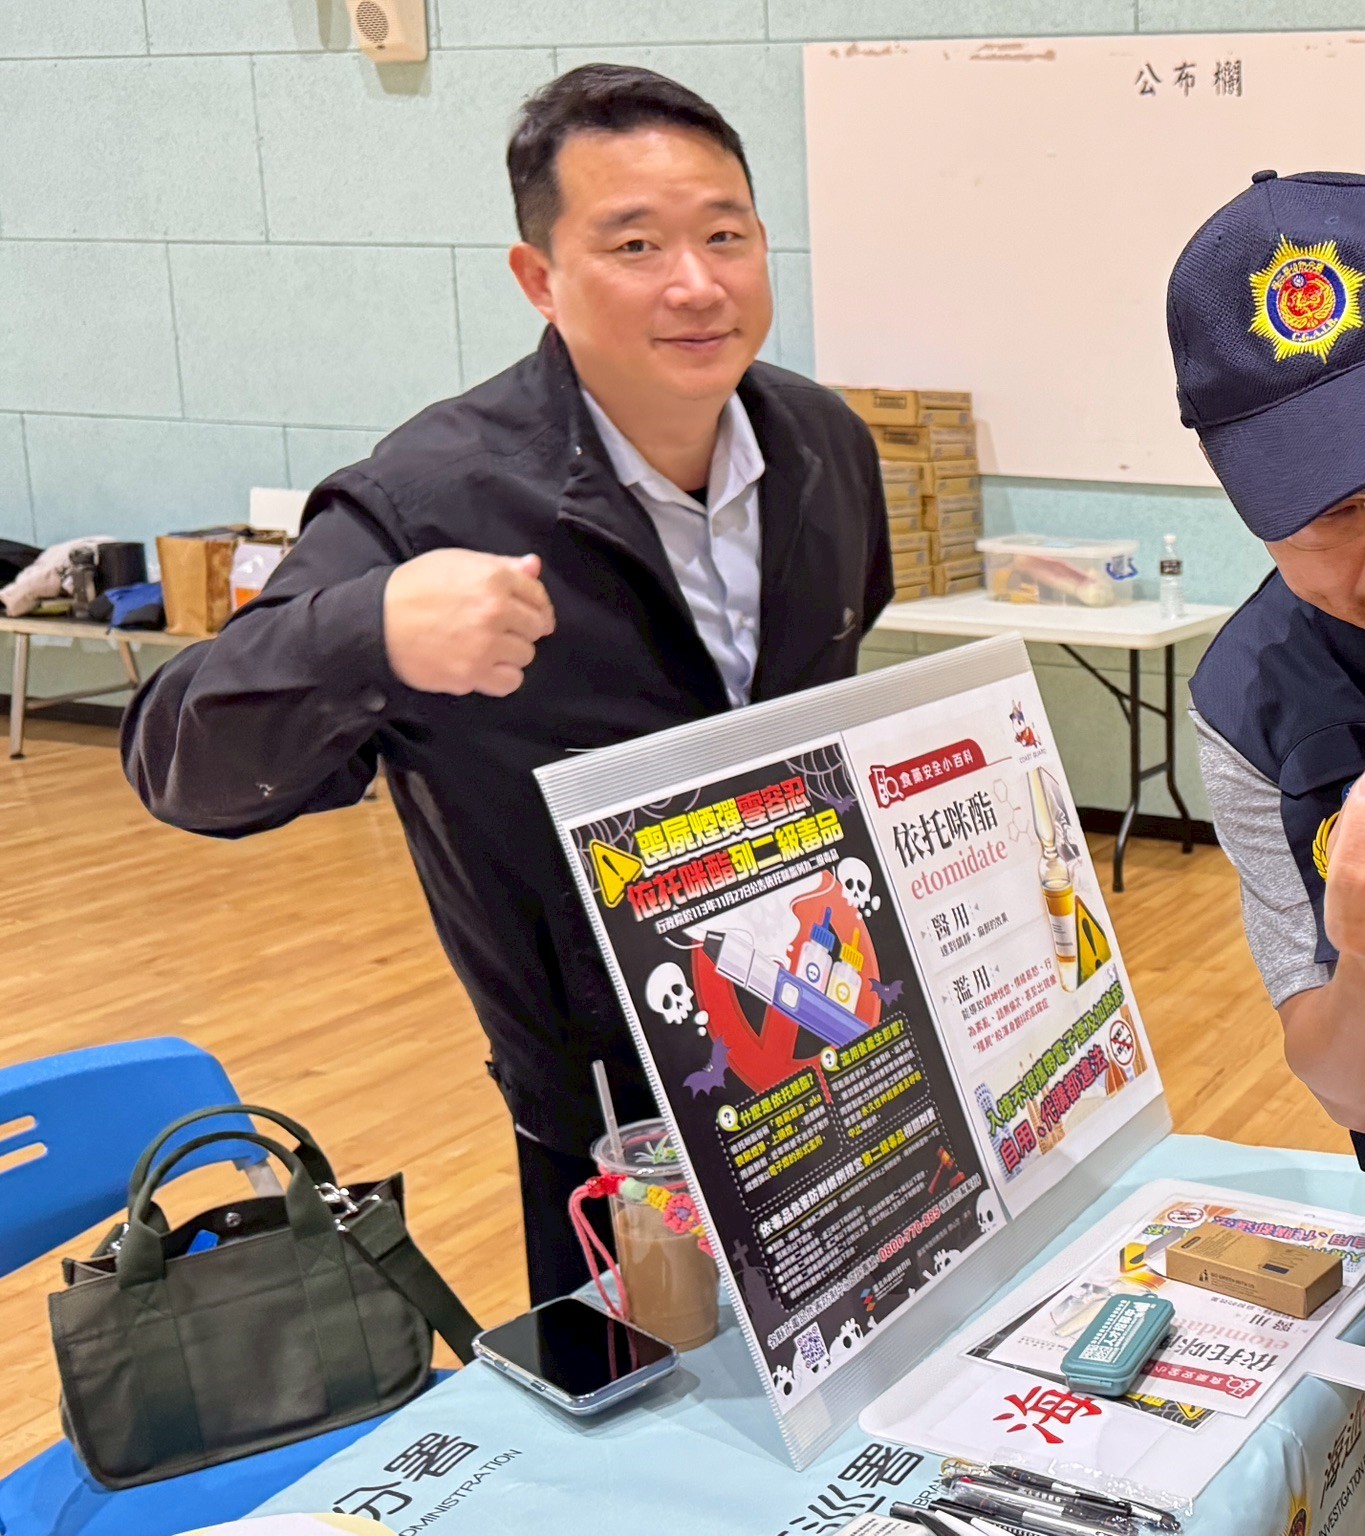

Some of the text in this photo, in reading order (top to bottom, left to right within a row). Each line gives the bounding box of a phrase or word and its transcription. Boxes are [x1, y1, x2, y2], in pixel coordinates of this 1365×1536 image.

[1135, 60, 1242, 97] 公布欄
[897, 746, 974, 792] 食藥安全小百科
[632, 774, 812, 867] 喪屍煙彈零容忍
[888, 784, 998, 872] 依托咪酯
[623, 807, 845, 923] 依托咪酯列二級毒品
[907, 831, 1009, 904] etomidate
[997, 1038, 1110, 1174] 自用、代購都違法
[992, 1386, 1102, 1444] 海
[332, 1432, 479, 1521] 分署
[400, 1448, 523, 1536] DMINISTRATION
